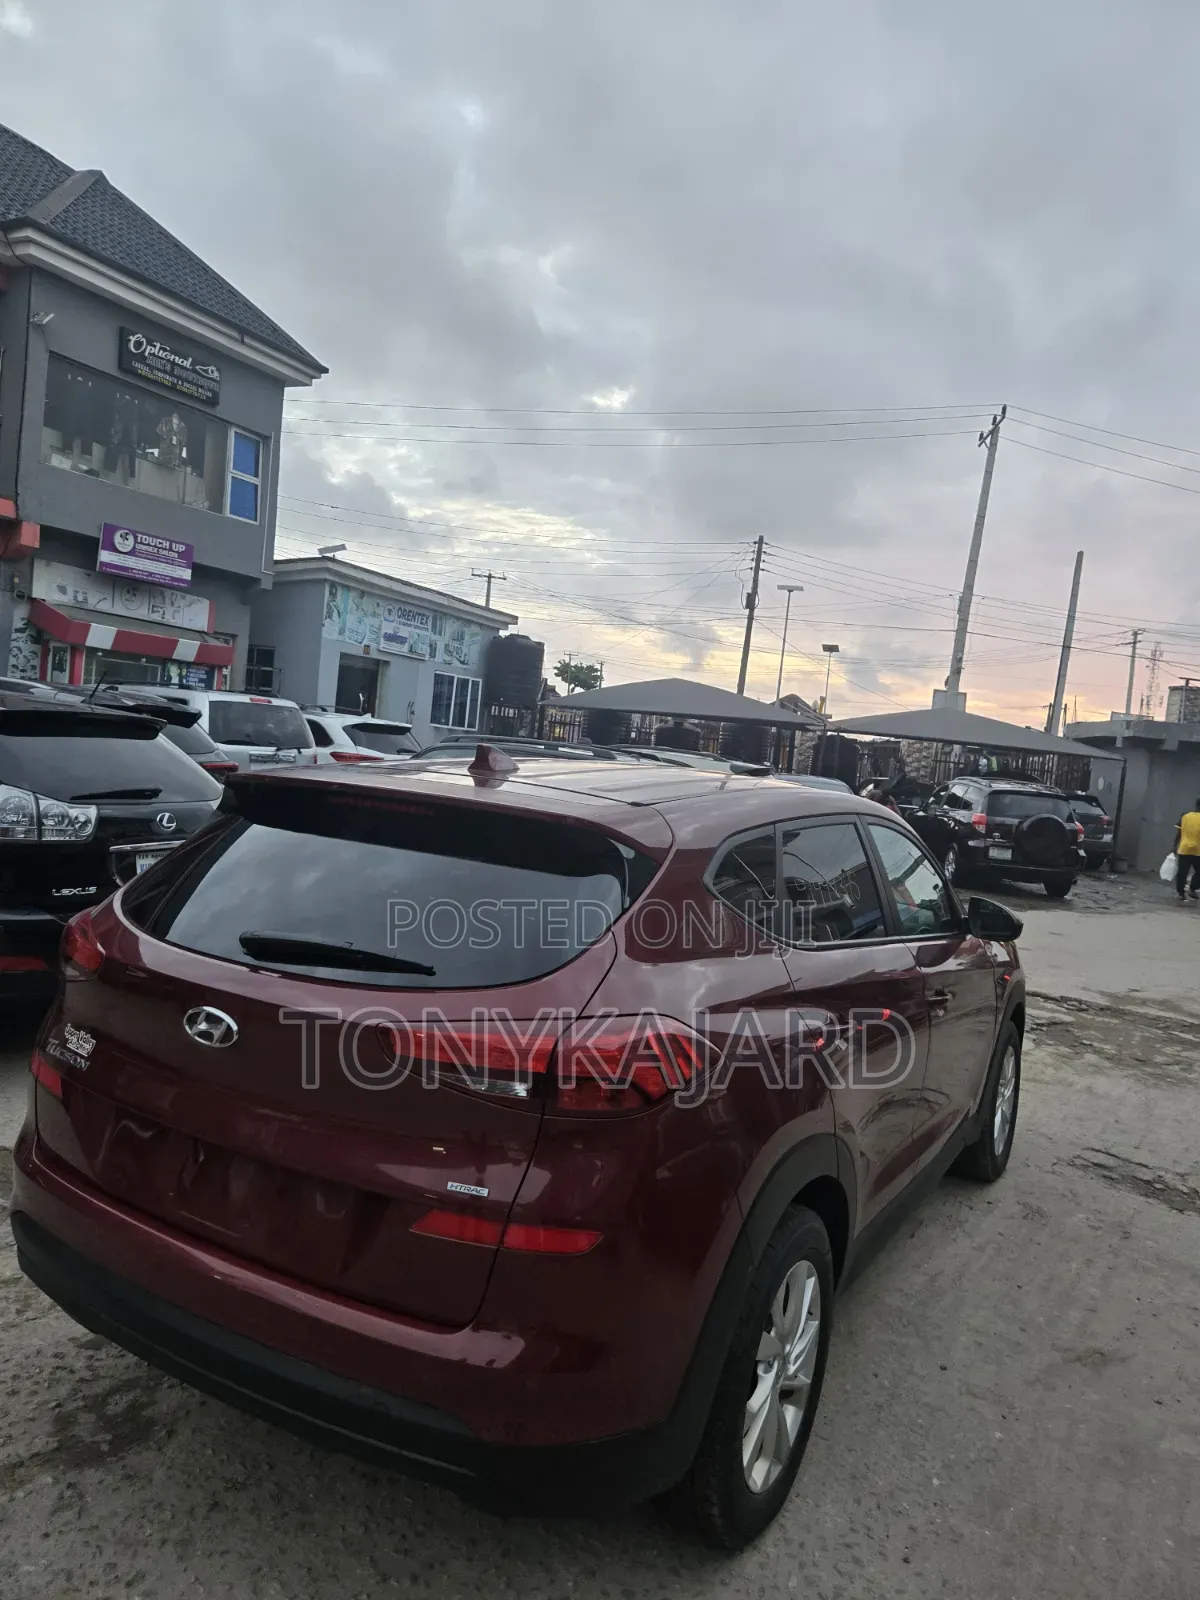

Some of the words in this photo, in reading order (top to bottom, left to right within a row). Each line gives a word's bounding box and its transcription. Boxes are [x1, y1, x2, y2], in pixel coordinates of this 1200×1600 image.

[127, 333, 193, 369] Optional
[135, 542, 159, 554] UNISEX
[158, 548, 179, 559] SALON
[136, 533, 170, 550] TOUCH
[171, 543, 186, 553] UP
[396, 606, 430, 627] ORENTEX
[52, 886, 97, 896] LEXUS
[450, 1183, 486, 1195] HTRAC
